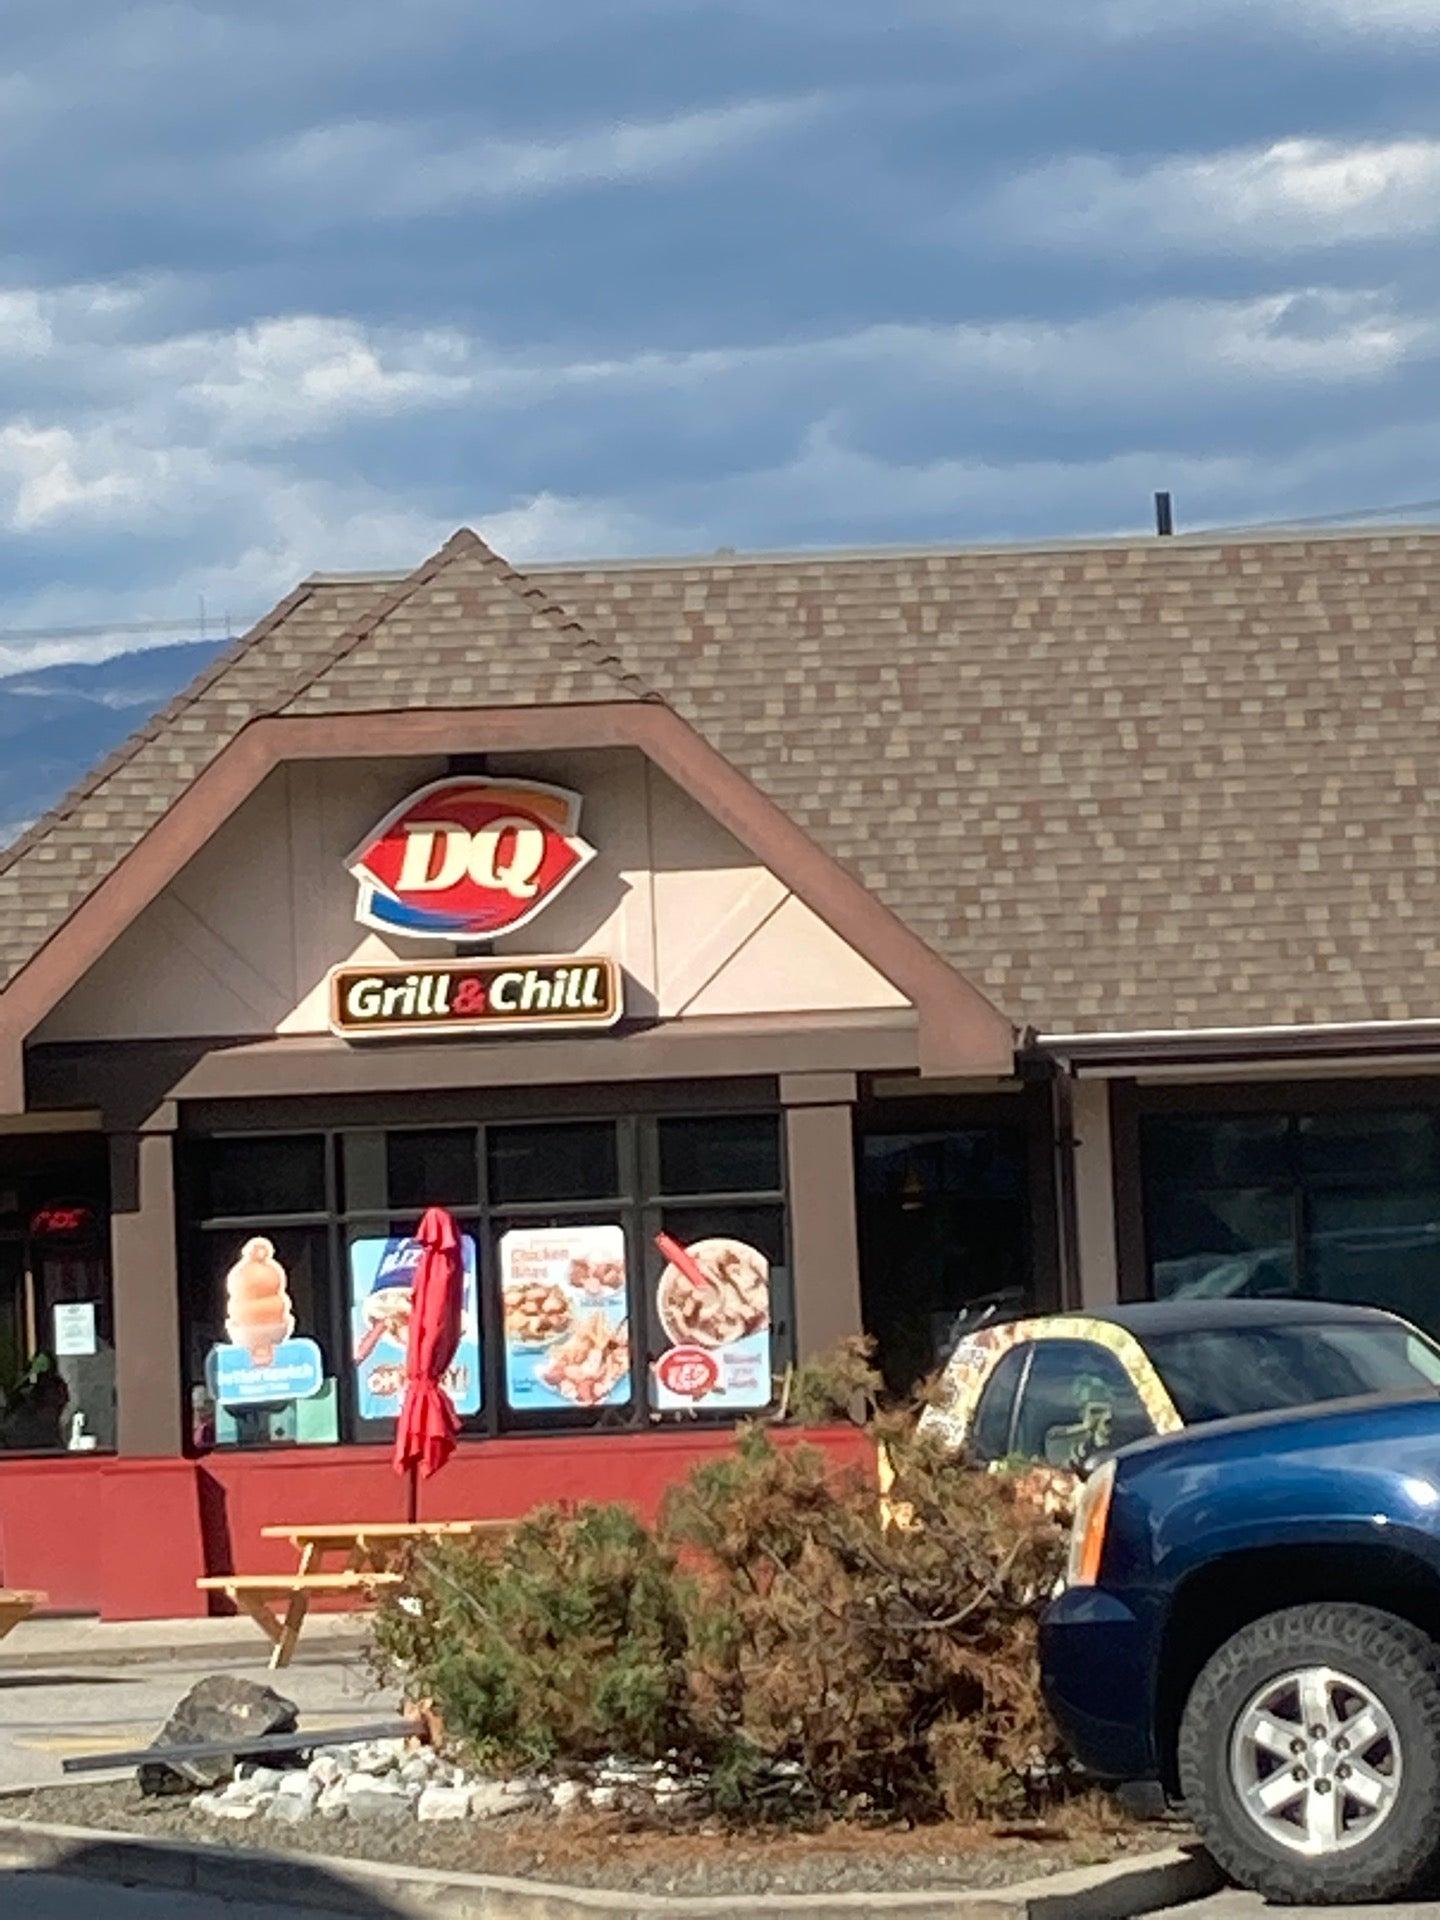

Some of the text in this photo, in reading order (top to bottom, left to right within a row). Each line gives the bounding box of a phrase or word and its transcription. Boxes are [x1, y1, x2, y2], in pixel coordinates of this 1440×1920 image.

[396, 817, 545, 898] DQ
[347, 968, 600, 1017] Grill & Chill
